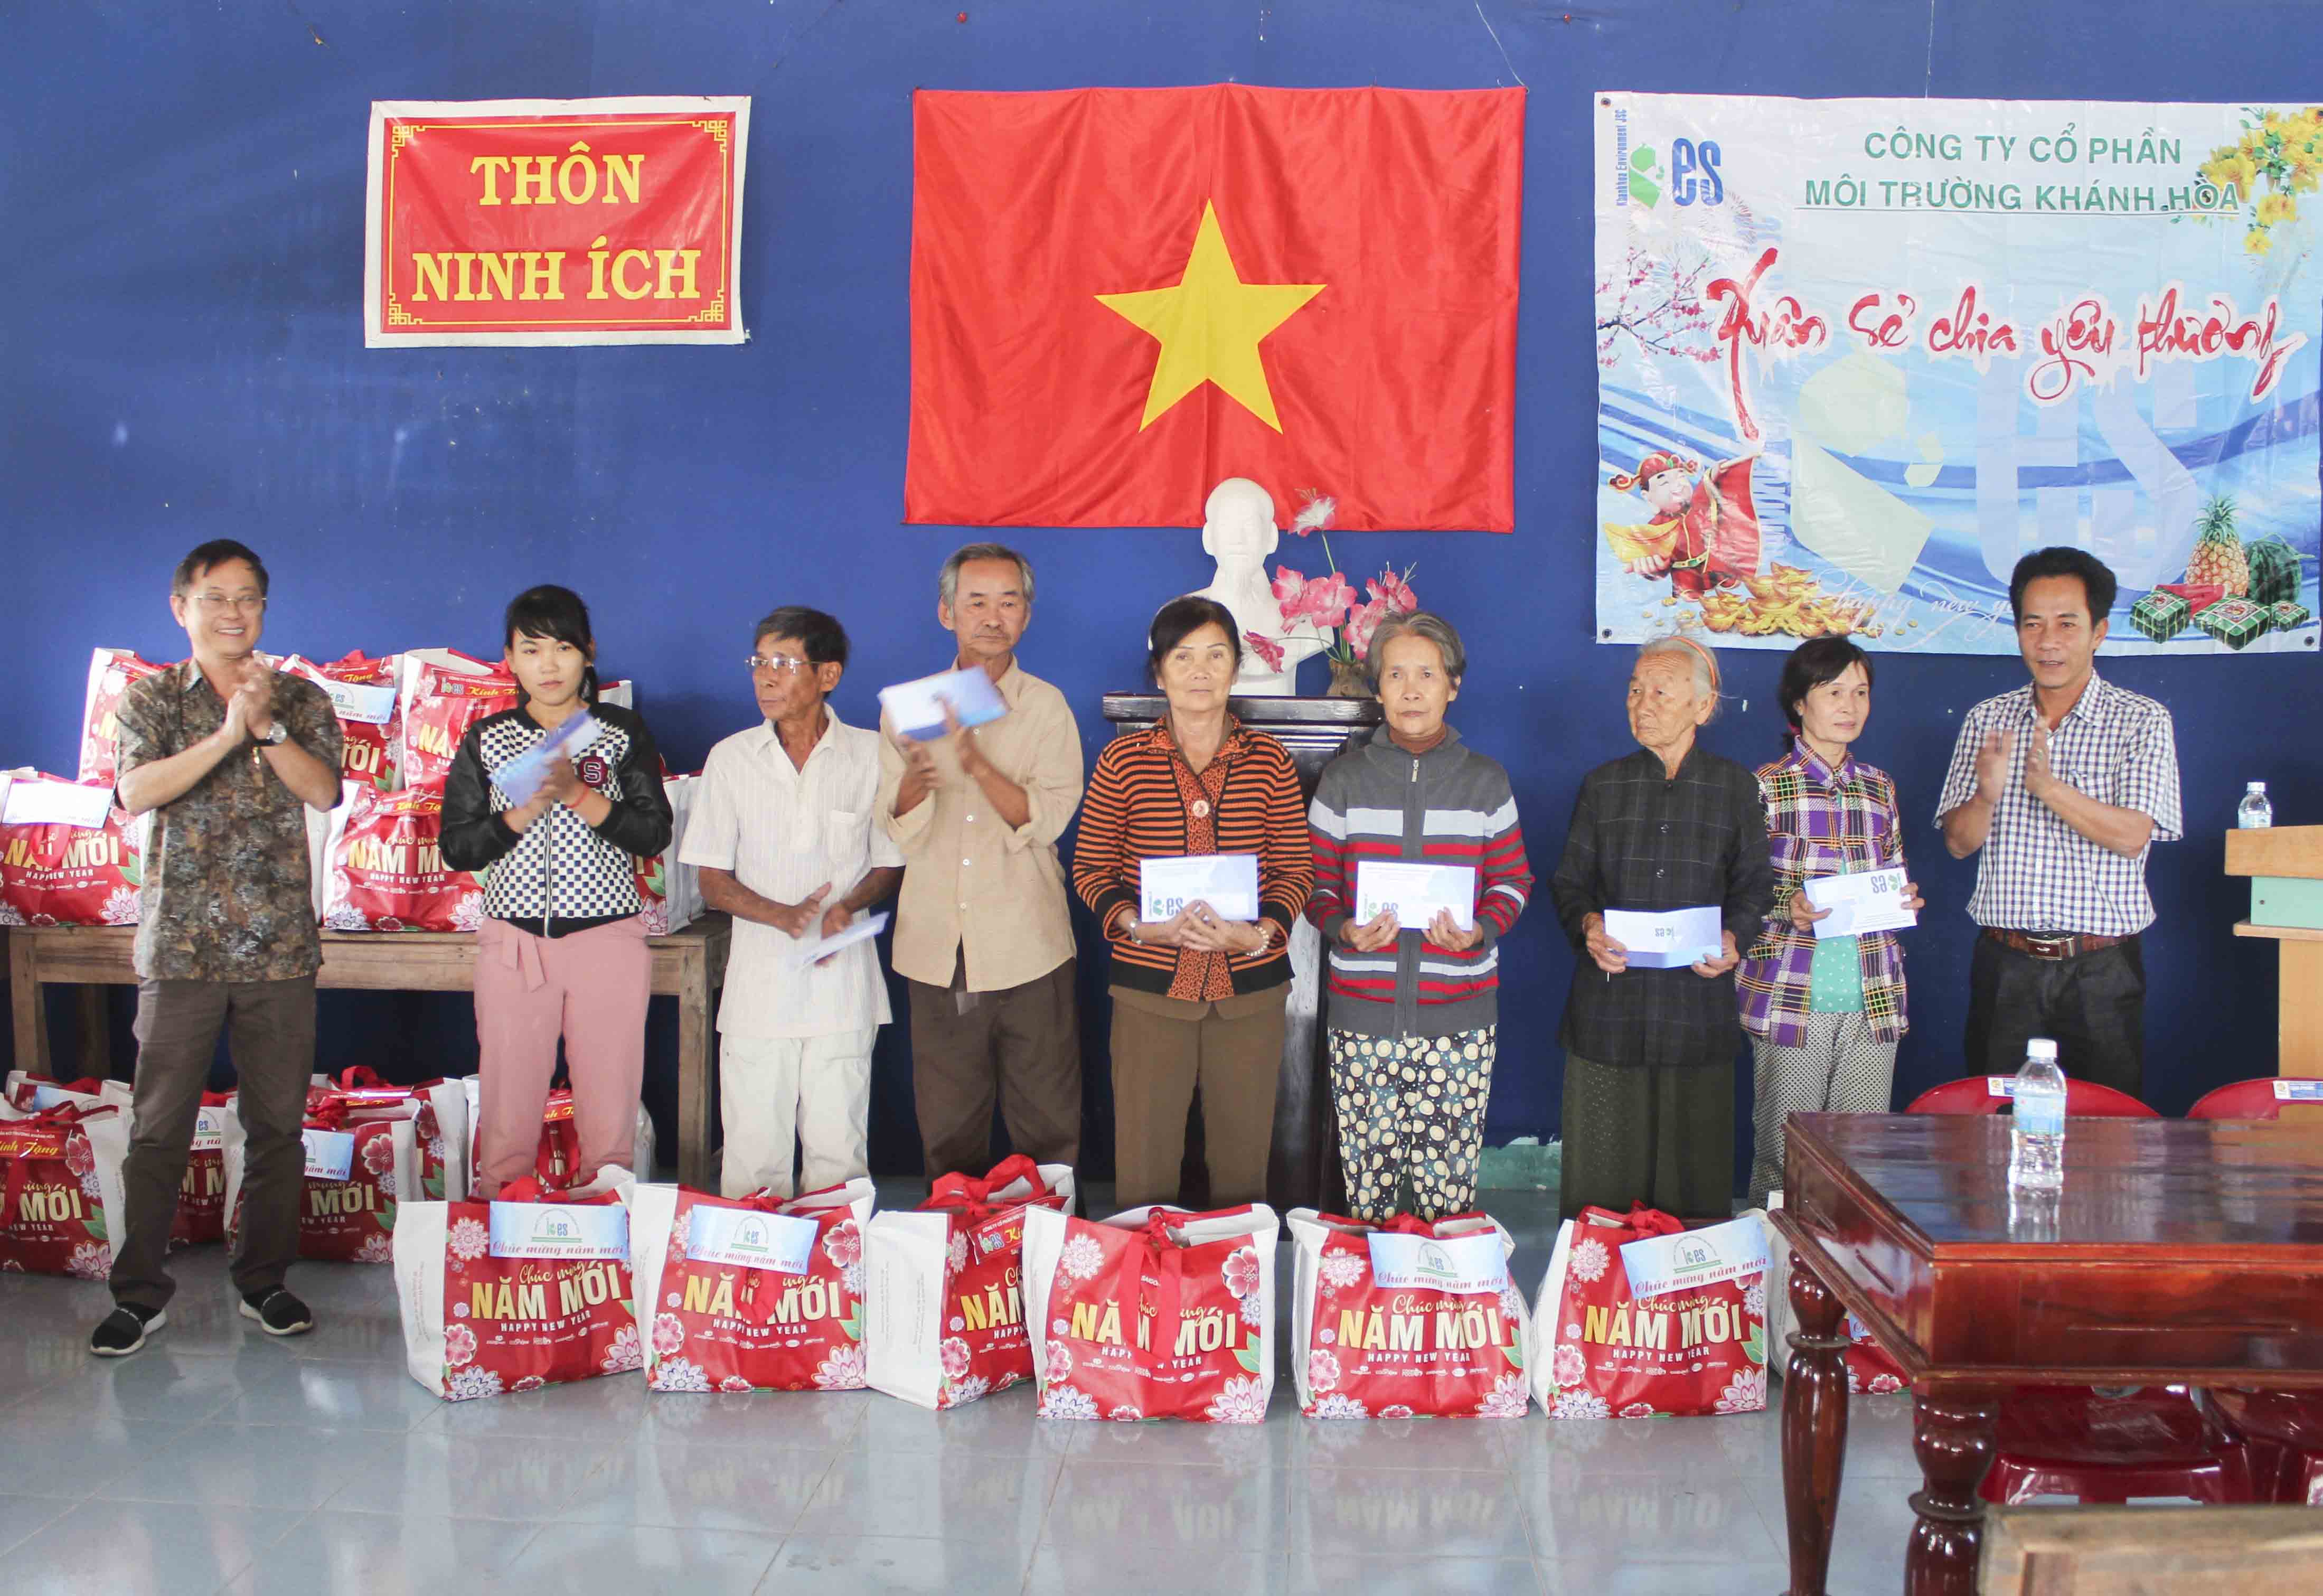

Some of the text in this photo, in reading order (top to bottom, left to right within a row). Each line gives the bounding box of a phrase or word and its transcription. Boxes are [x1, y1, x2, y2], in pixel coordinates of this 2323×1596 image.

[1615, 109, 1627, 123] JSC
[1865, 122, 2182, 164] CÔNG TY CỔ PHẦN
[470, 140, 644, 205] THÔN
[1805, 174, 2239, 211] MÔI TRƯỜNG KHÁNH HÒA
[411, 235, 702, 302] NINH ÍCH
[1929, 286, 2016, 355] chia
[2030, 301, 2114, 400] yêu
[584, 762, 601, 783] S
[371, 873, 394, 883] HAPPY
[20, 1183, 83, 1222] MỚI
[310, 1181, 374, 1216] MỚI
[492, 1241, 624, 1256] Chúc mừng năm mới
[690, 1243, 720, 1259] Chúc
[754, 1255, 777, 1265] năm
[1694, 1248, 1707, 1263] es
[519, 1264, 553, 1285] Chúc
[1377, 1271, 1409, 1284] Chúc
[1446, 1281, 1472, 1289] năm
[1477, 1276, 1504, 1287] mới
[1635, 1255, 1767, 1294] Chúc mừng năm mới
[472, 1276, 547, 1320] NĂM
[559, 1261, 622, 1317] MỚI
[1140, 1293, 1158, 1317] húc
[1393, 1293, 1433, 1315] Chúc
[1638, 1296, 1678, 1313] Chúc
[501, 1310, 591, 1332] HAPPY NEW YEAR
[777, 1324, 807, 1336] YEAR
[1337, 1300, 1502, 1352] NĂM MỚI
[1584, 1297, 1742, 1351] NĂM MỚI
[1171, 1356, 1202, 1369] YEAR
[1368, 1352, 1470, 1364] HAPPY NEW YEAR
[1613, 1348, 1652, 1362] HAPPY
[1659, 1350, 1684, 1362] NEW
